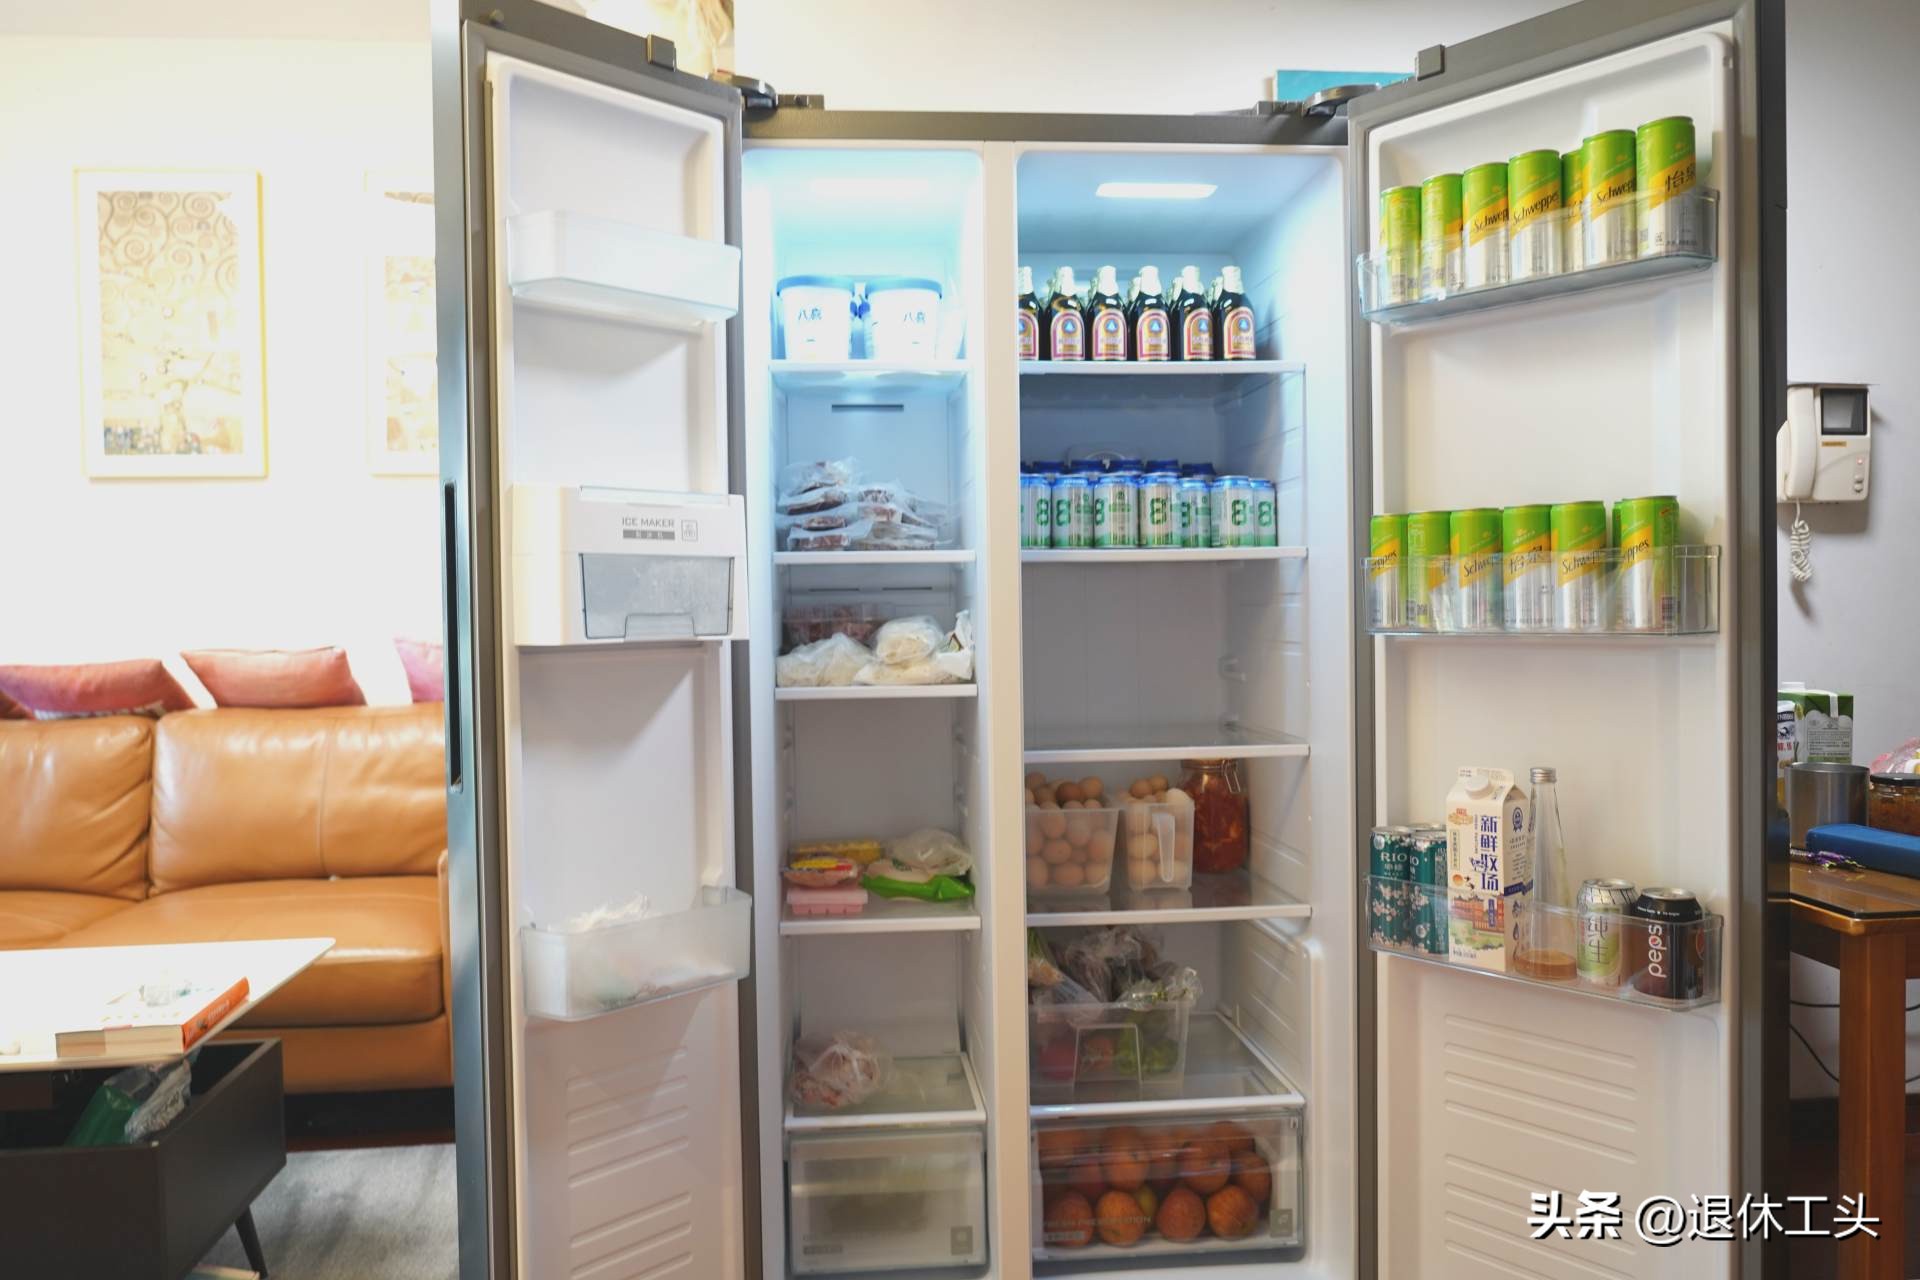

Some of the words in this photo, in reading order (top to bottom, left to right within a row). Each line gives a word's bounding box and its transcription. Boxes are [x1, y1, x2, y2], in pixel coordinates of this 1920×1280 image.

[622, 517, 638, 527] ICE
[641, 518, 675, 528] MAKER
[1056, 498, 1071, 526] 8
[1150, 498, 1167, 525] 8
[1231, 499, 1247, 526] 8
[1258, 501, 1272, 528] 8
[1380, 851, 1408, 863] RIO
[1480, 815, 1499, 891] 新鲜牧场
